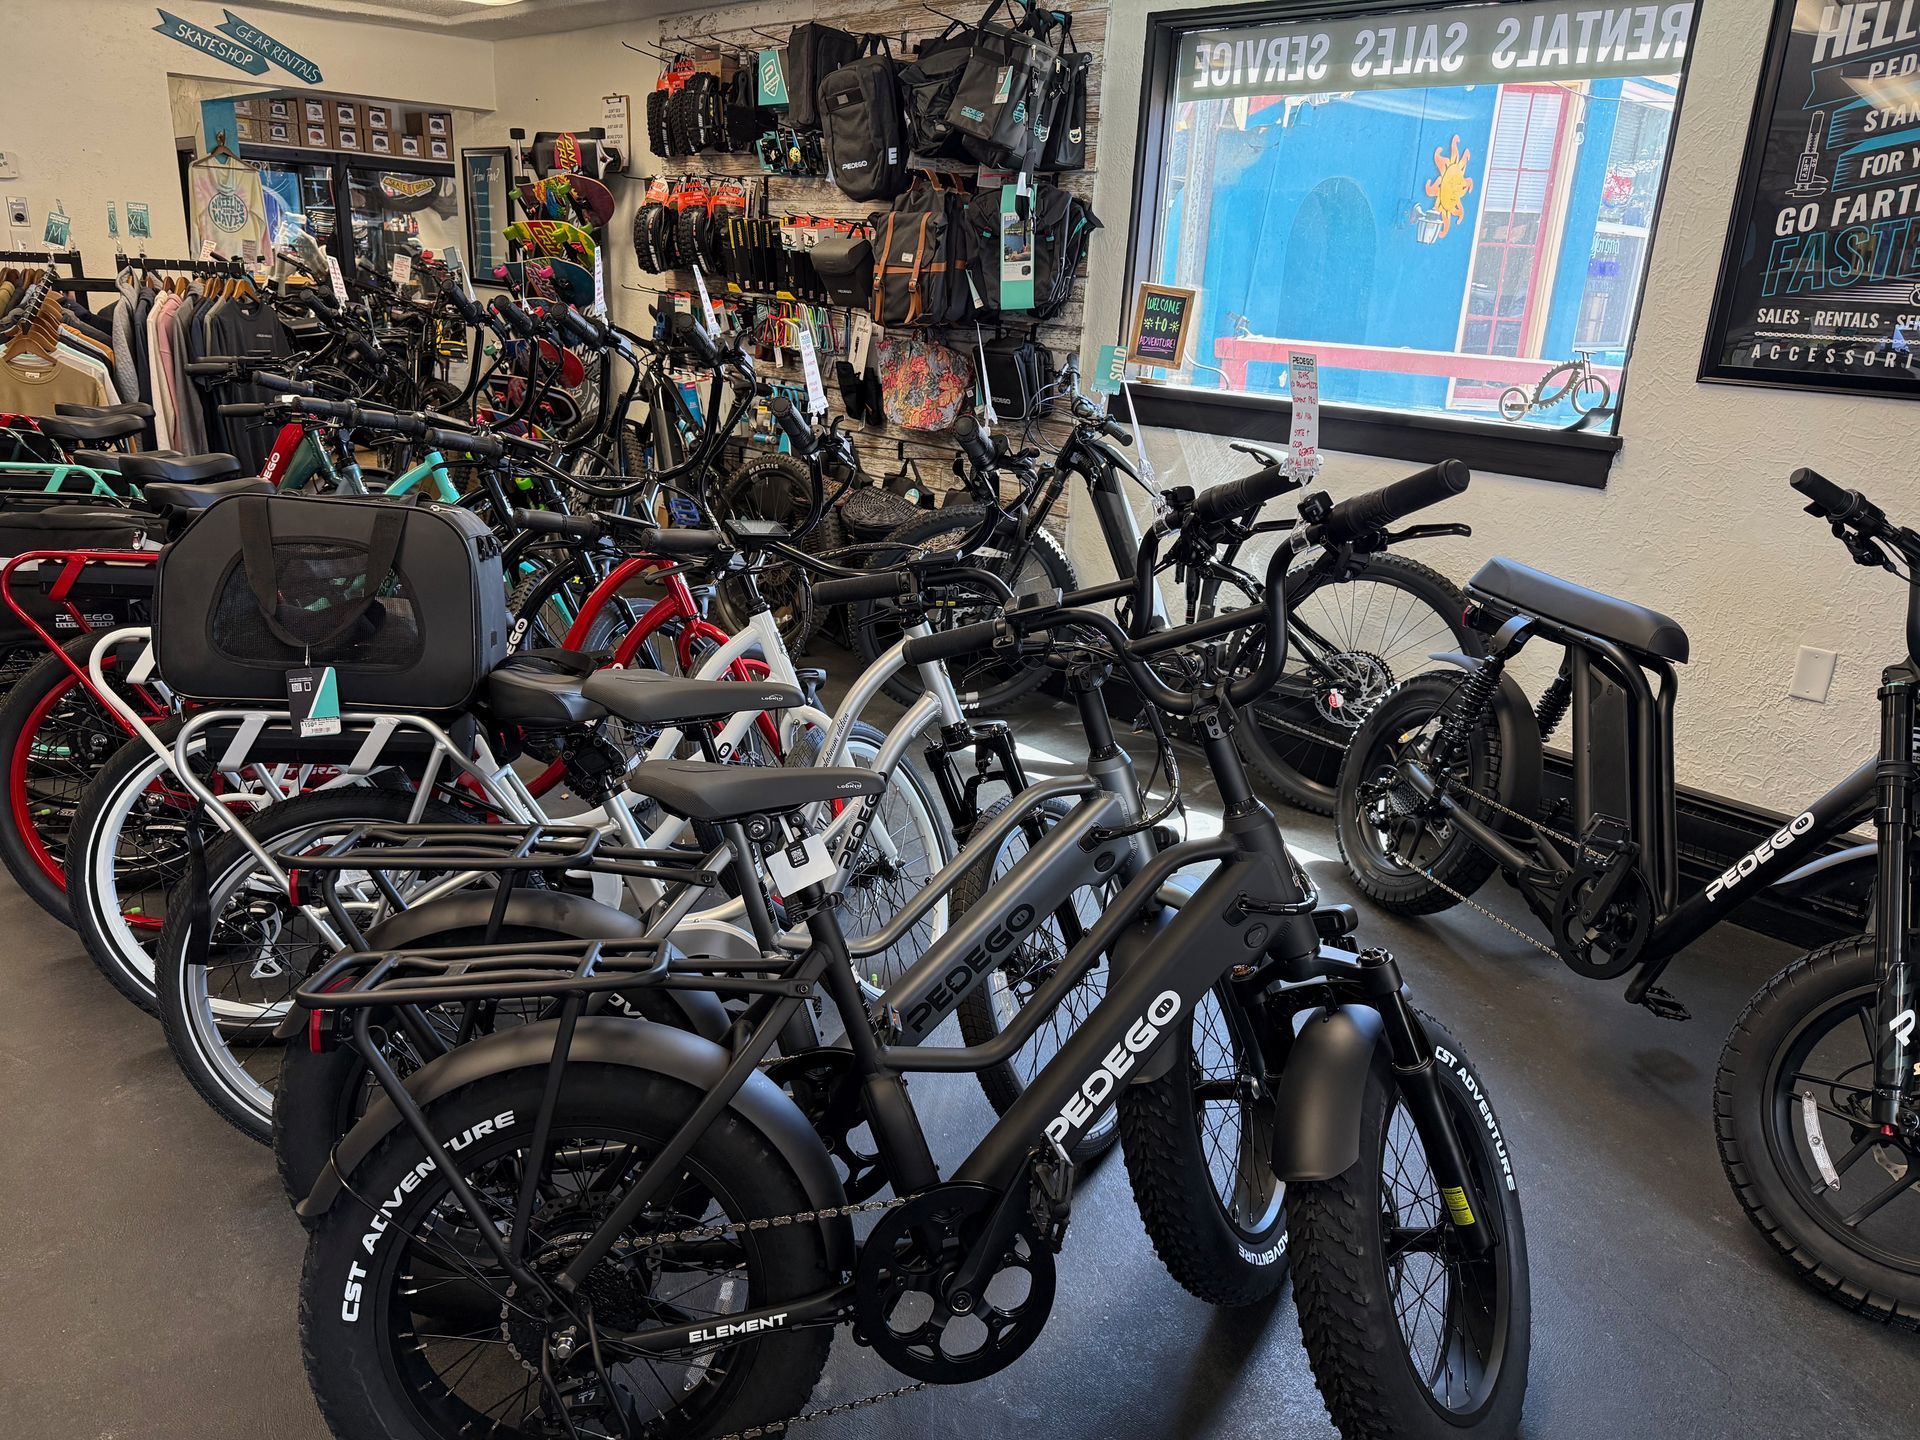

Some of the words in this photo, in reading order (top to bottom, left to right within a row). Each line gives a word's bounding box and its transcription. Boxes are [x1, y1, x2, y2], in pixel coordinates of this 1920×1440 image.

[175, 24, 253, 66] SKATESHOP
[1812, 0, 1920, 63] HELL
[235, 25, 270, 52] GEAR
[270, 45, 320, 82] RENTALS
[1868, 53, 1920, 84] PED
[842, 160, 868, 170] PEDEGO
[1860, 150, 1905, 179] FOR
[128, 214, 146, 230] XL
[212, 209, 245, 227] WAVES
[1776, 203, 1819, 236] GO
[1831, 183, 1920, 227] FART
[48, 225, 62, 242] M
[1147, 296, 1181, 315] WELCOME
[1757, 308, 1800, 325] SALES
[1814, 310, 1880, 329] RENTALS
[1139, 335, 1175, 349] ADVENTURE!
[1751, 343, 1912, 370] ACCESSORI
[1110, 347, 1126, 381] SOLD
[1293, 356, 1314, 366] PEDEGO
[262, 452, 281, 480] EGO
[56, 613, 113, 622] PEEGO
[506, 617, 528, 656] EGO
[838, 794, 879, 869] PEDEG
[1705, 811, 1815, 903] PEDEGO
[907, 904, 1035, 1033] PEDEGO
[1045, 990, 1181, 1143] PEDEGO
[1435, 1046, 1458, 1068] CST
[1456, 1066, 1516, 1191] ADVENTURE
[1238, 1230, 1289, 1266] ADVENTURE
[342, 1261, 366, 1322] CST
[689, 1313, 787, 1344] ELEMENT
